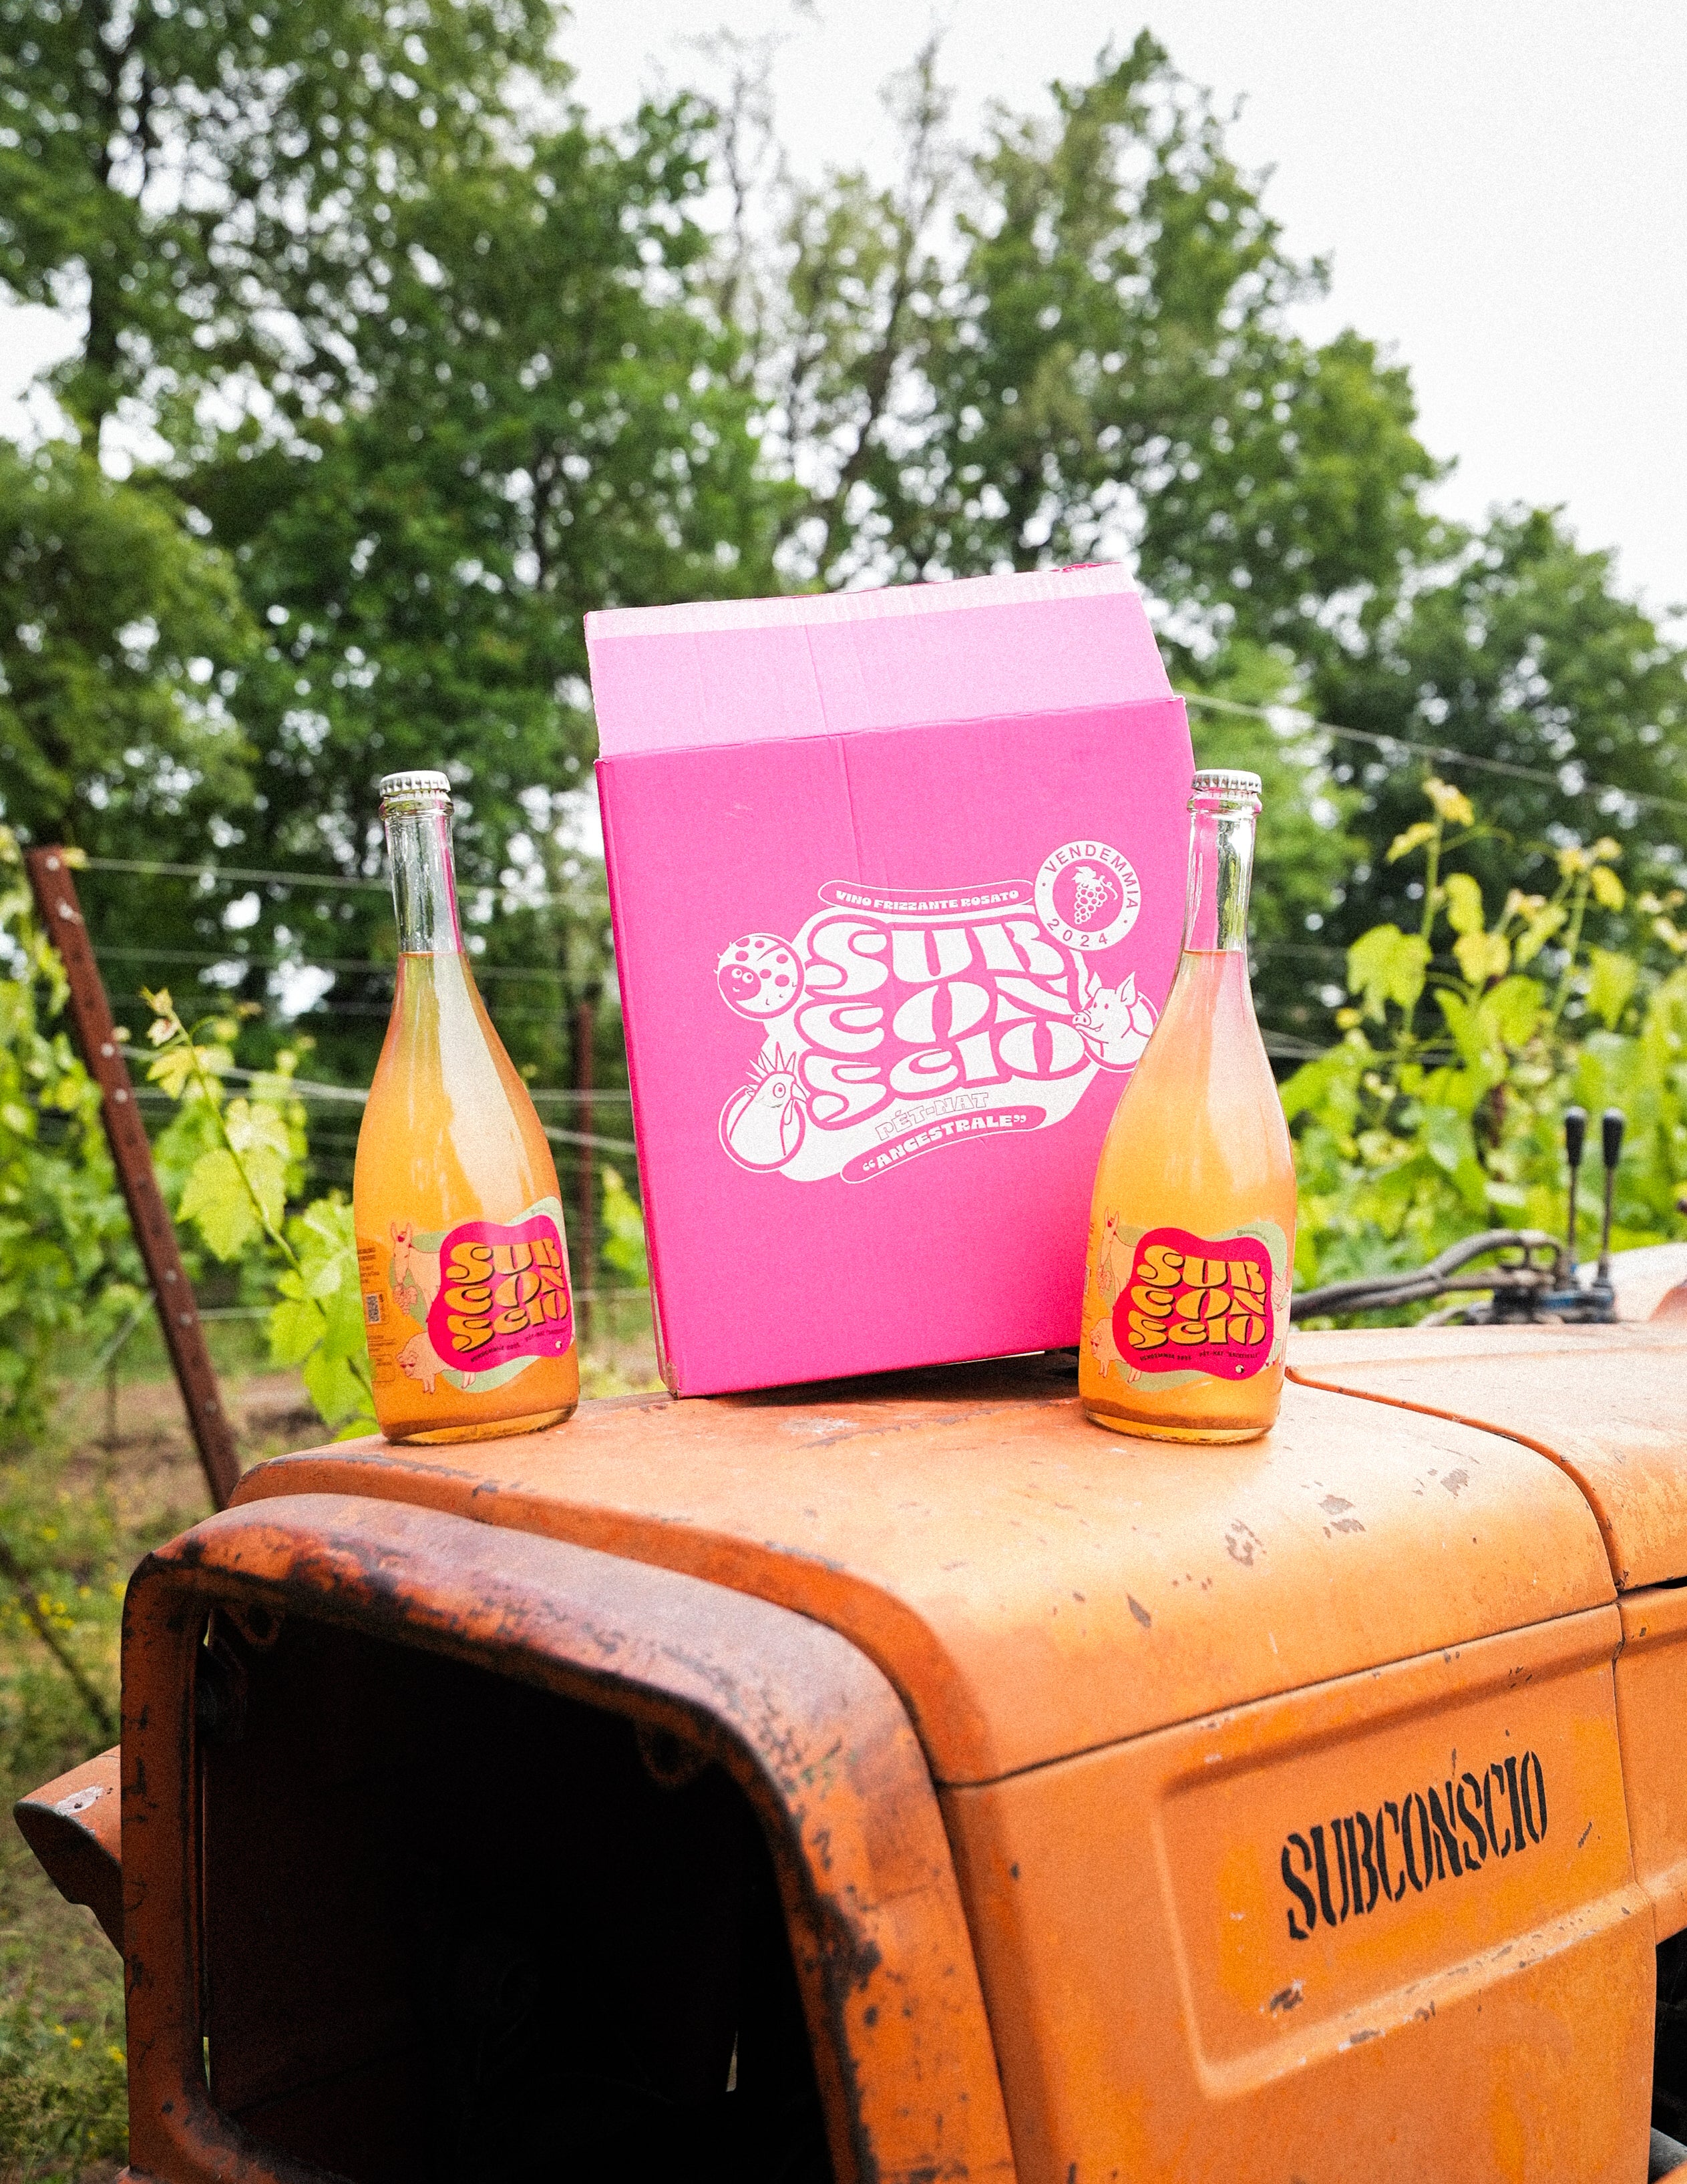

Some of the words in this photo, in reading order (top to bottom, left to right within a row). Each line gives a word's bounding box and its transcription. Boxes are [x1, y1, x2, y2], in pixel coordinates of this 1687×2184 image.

[836, 890, 872, 906] VINO
[874, 899, 958, 910] FRIZZANTE
[961, 890, 1019, 907] ROSATO
[1045, 844, 1139, 908] VENDEMMIA
[1047, 918, 1107, 947] 2024
[804, 920, 1065, 996] SUB
[799, 975, 1076, 1053] CON
[875, 1093, 988, 1141] PÉT-NAT
[445, 1238, 561, 1286] SUB
[1137, 1245, 1267, 1294] SUB
[443, 1268, 565, 1315] CON
[1131, 1286, 1267, 1321] CON
[1281, 1750, 1547, 1940] SUBCONSCIO
